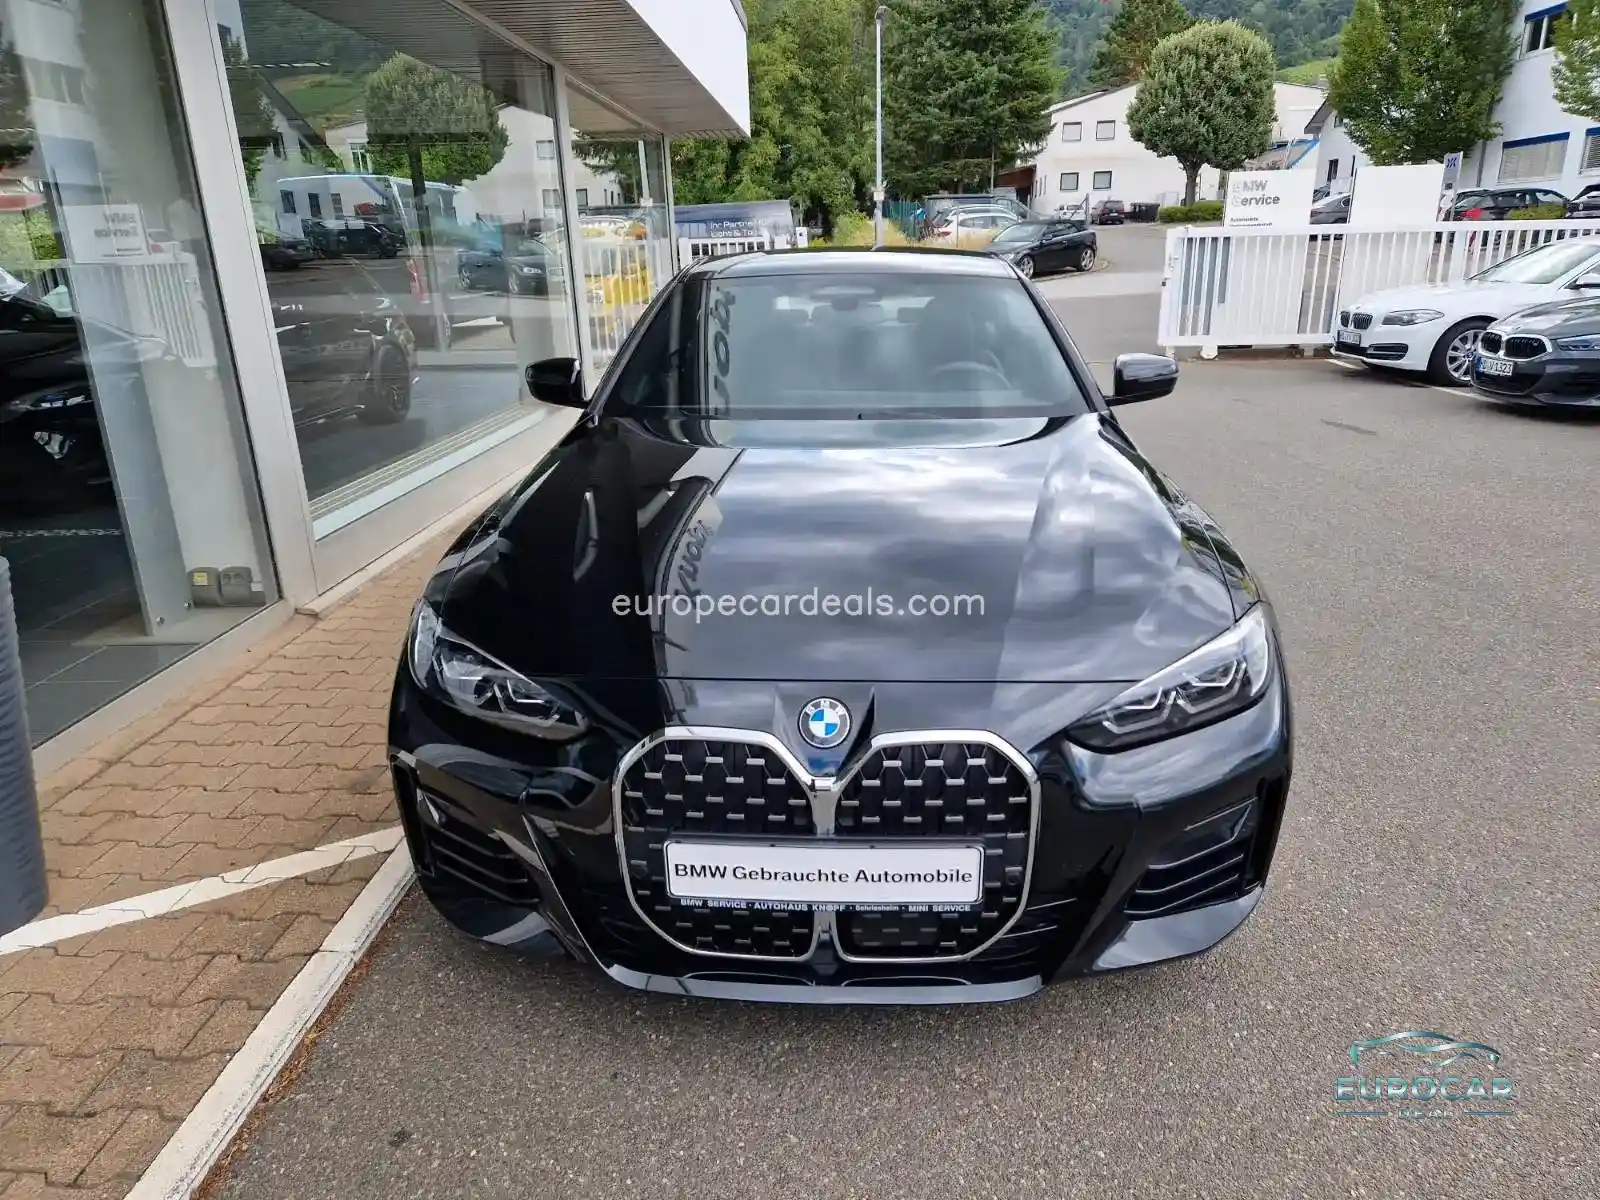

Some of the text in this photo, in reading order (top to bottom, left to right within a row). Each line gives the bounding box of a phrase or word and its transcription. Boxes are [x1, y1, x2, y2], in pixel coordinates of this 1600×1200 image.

[805, 700, 847, 717] BMW
[674, 862, 973, 884] BMW Gebrauchte Automobile
[680, 898, 703, 907] BMW
[707, 899, 747, 909] SERVICE
[753, 901, 809, 911] AUTOHAUS
[908, 904, 929, 912] MINI
[932, 903, 971, 912] SERVICE
